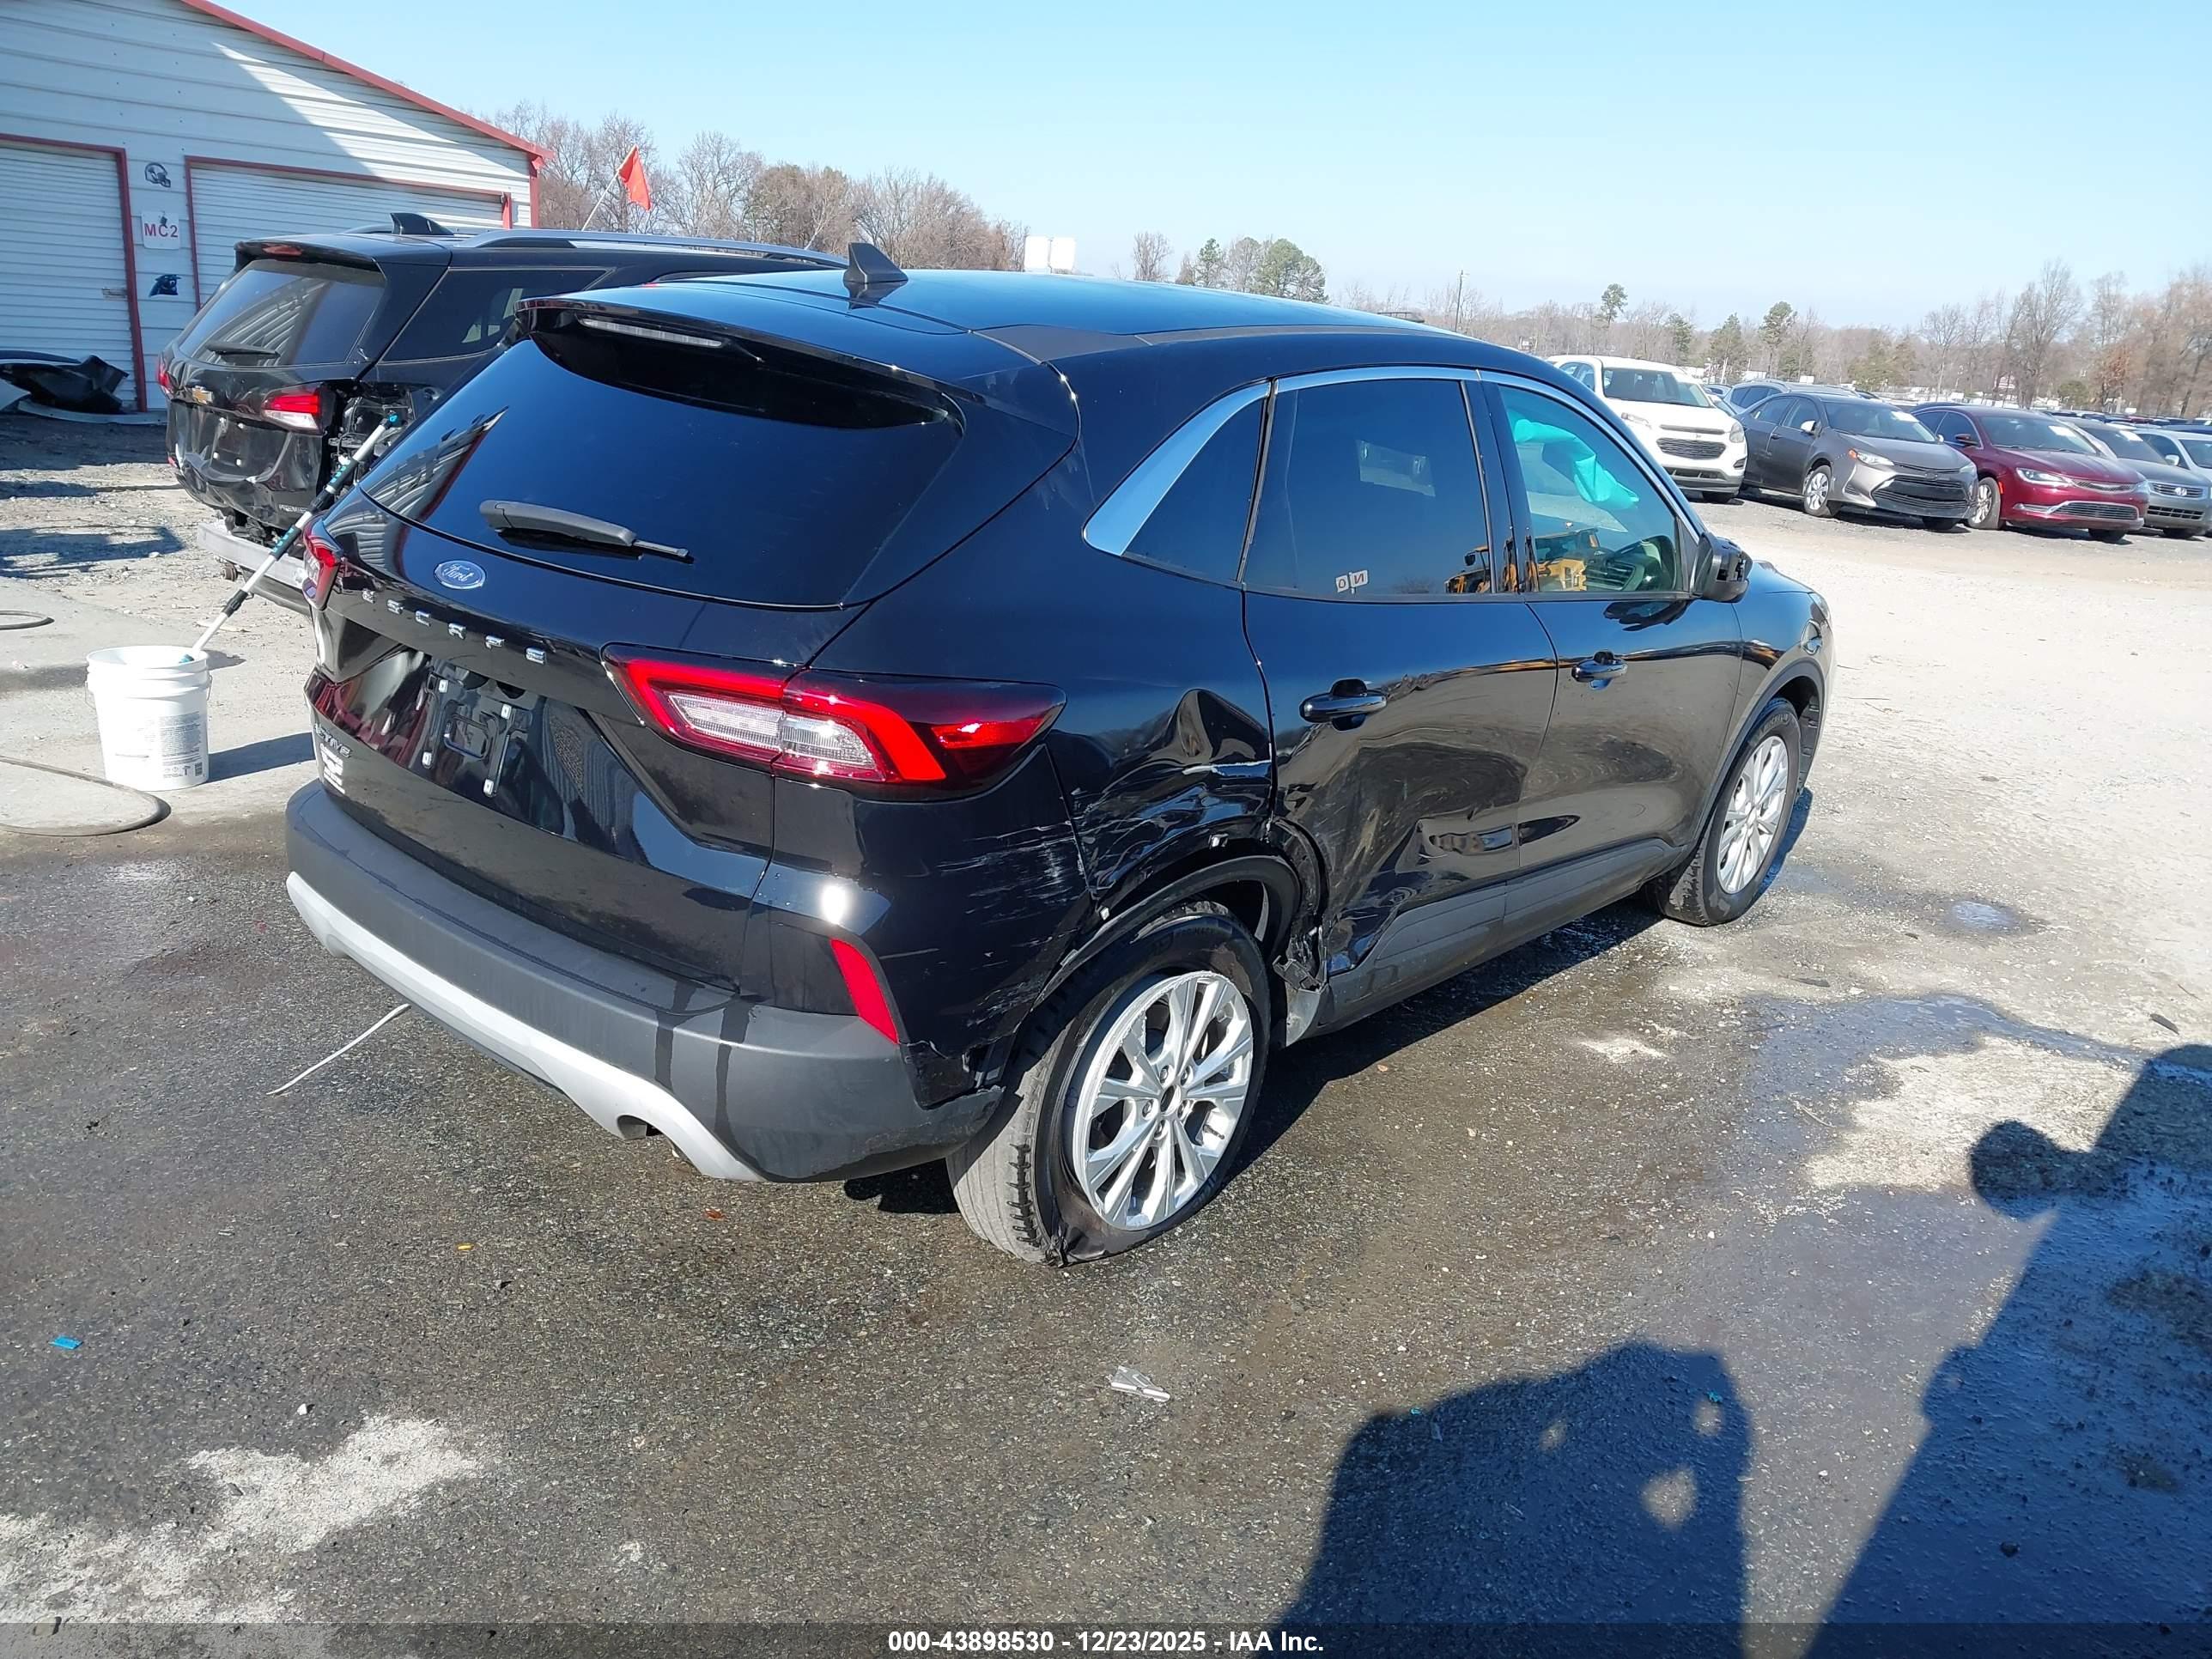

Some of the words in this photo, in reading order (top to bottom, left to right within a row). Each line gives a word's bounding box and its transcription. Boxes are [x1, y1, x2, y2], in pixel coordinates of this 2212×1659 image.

[143, 222, 178, 238] MC2
[441, 562, 475, 582] Ford
[361, 588, 548, 665] ESCAPE
